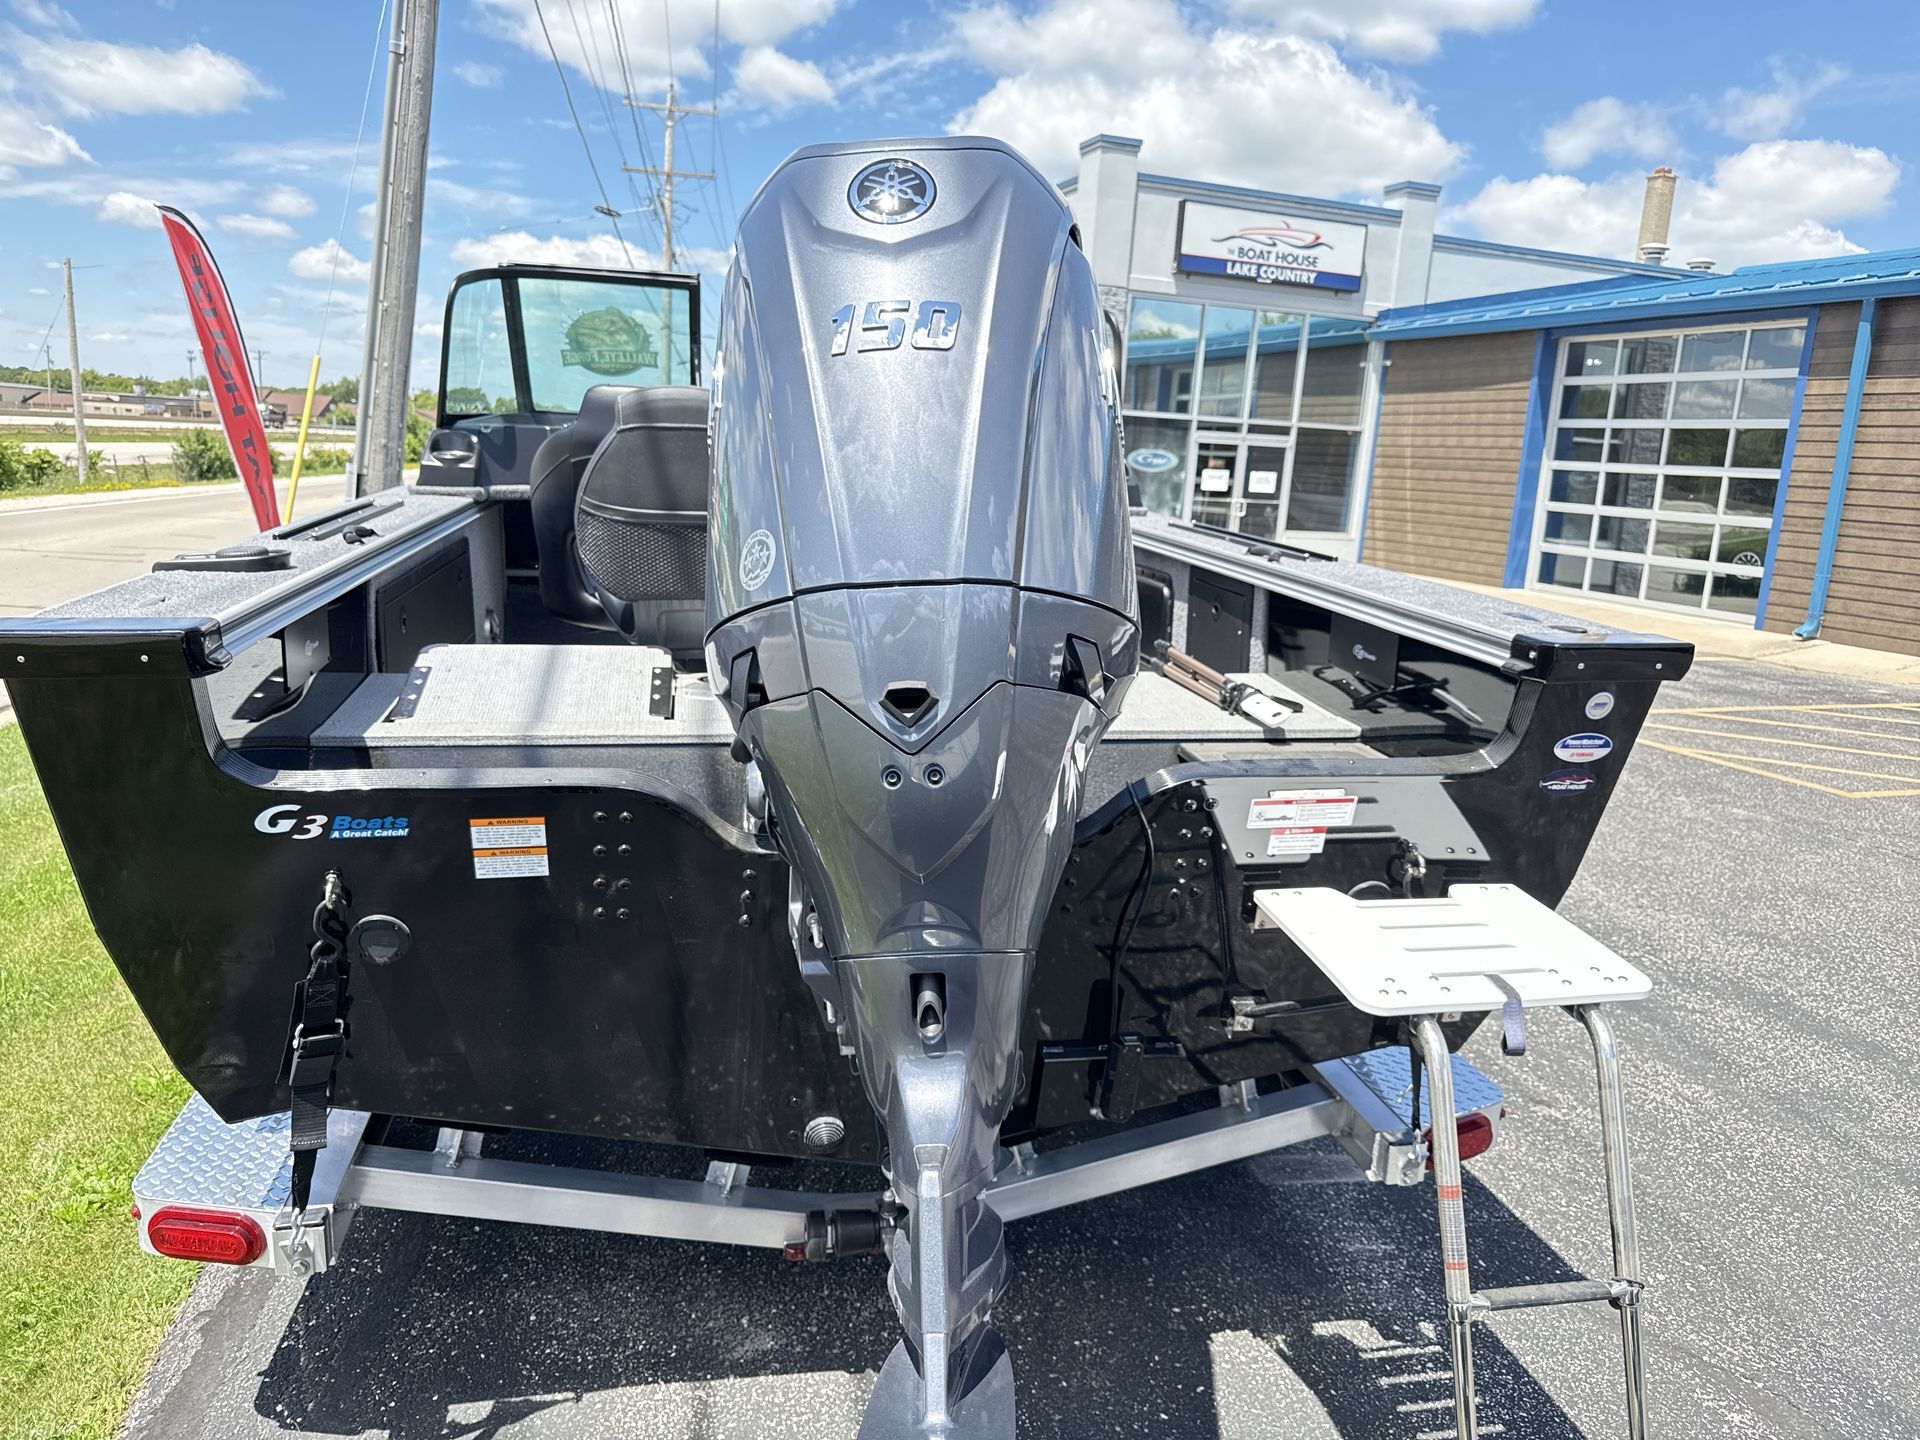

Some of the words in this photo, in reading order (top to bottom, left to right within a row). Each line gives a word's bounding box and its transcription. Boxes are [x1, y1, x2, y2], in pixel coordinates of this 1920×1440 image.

[1238, 247, 1272, 261] BOAT
[1275, 251, 1319, 268] HOUSE
[1226, 261, 1257, 277] LAKE
[1259, 265, 1319, 284] COUNTRY
[831, 300, 962, 357] 150
[254, 804, 329, 840] G3
[332, 815, 409, 830] Boats
[331, 830, 340, 838] A
[342, 830, 372, 838] Great
[374, 828, 409, 837] Catch!
